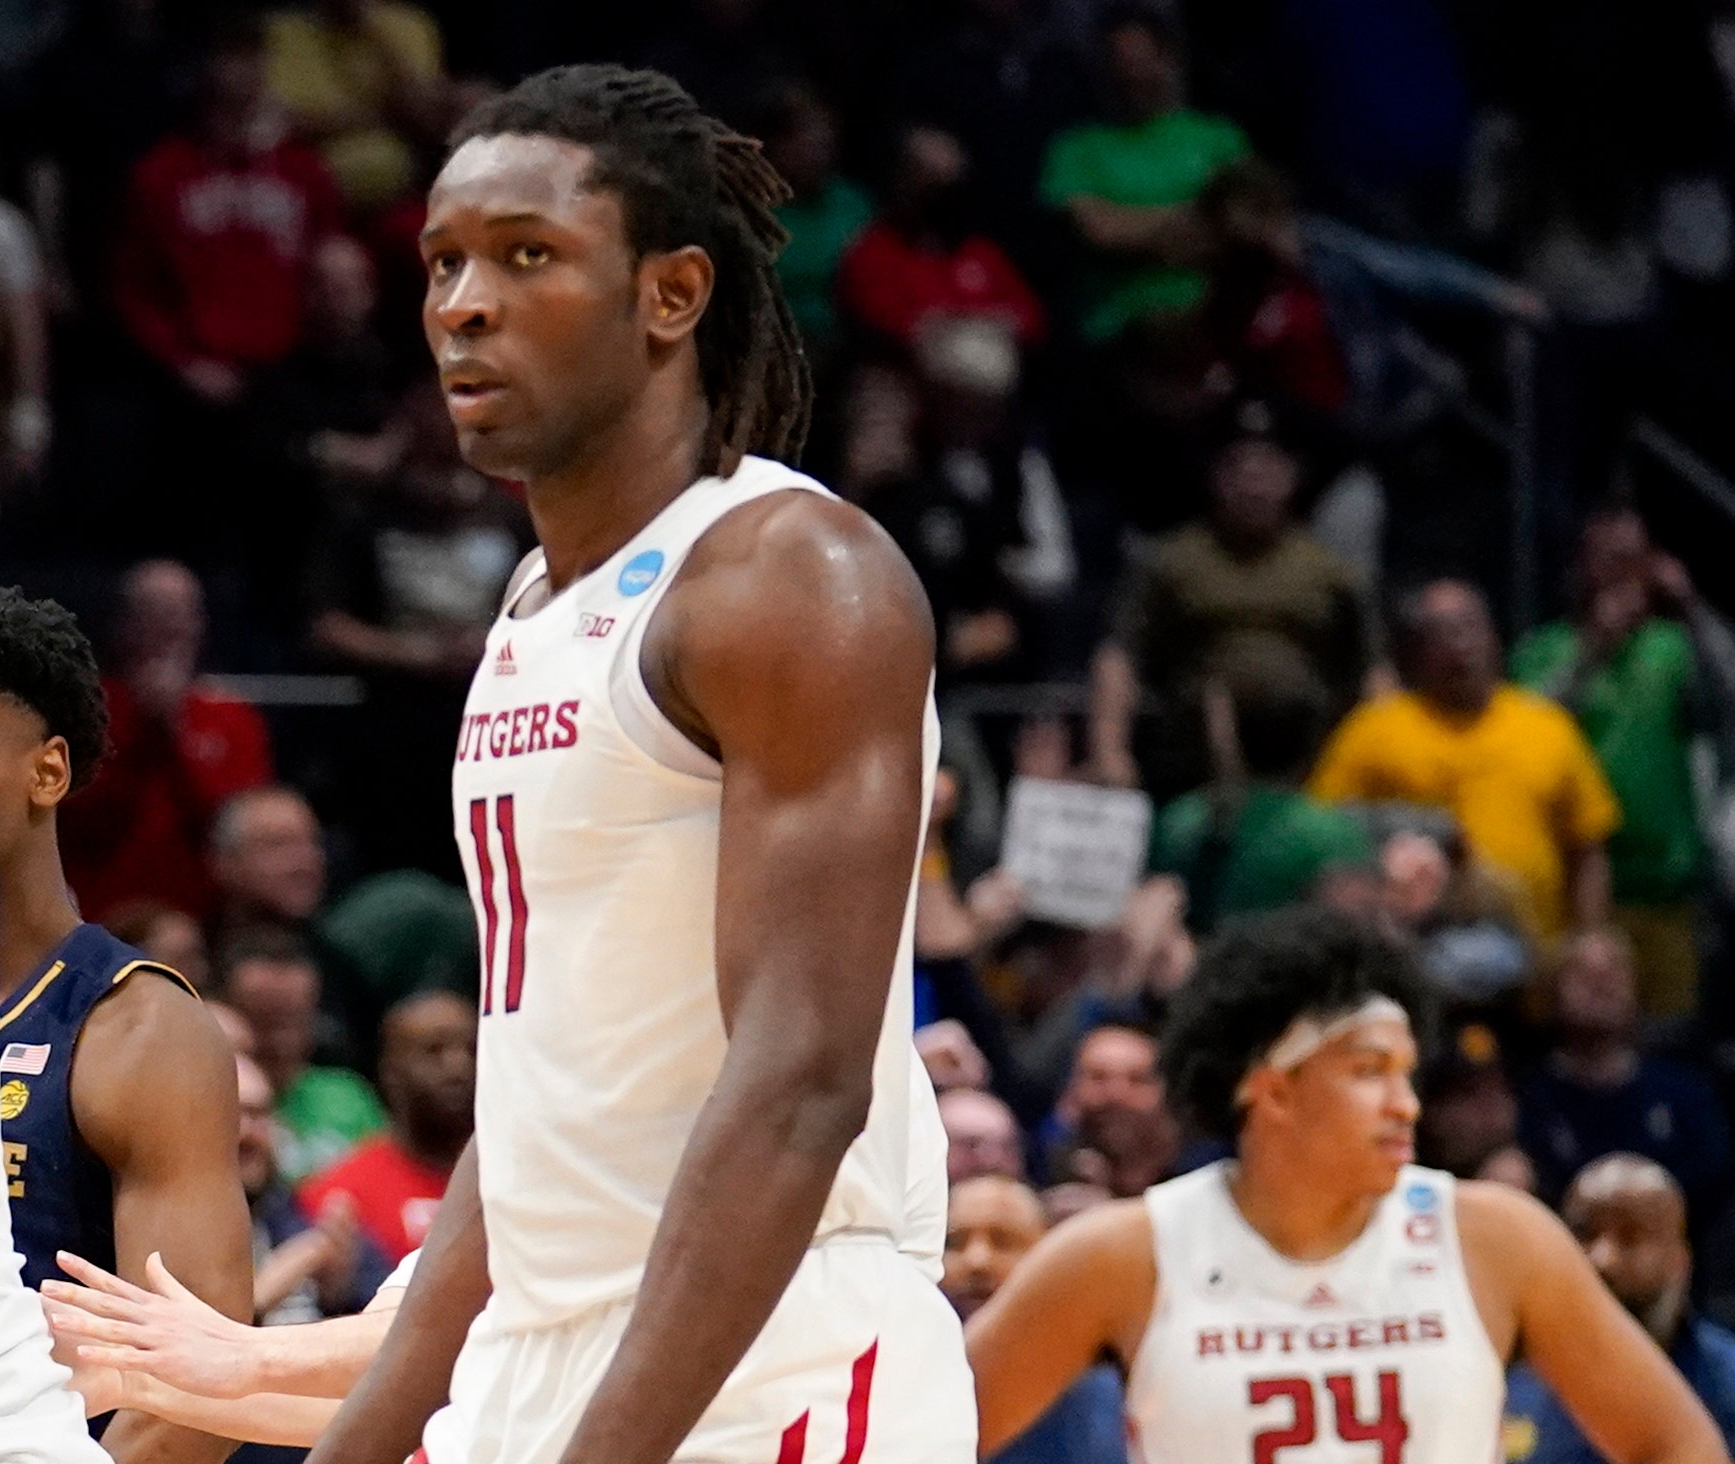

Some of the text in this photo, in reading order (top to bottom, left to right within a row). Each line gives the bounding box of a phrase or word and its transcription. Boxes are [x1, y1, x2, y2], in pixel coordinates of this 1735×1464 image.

[457, 699, 581, 763] UTGERS
[469, 793, 529, 1017] 11
[1198, 1315, 1446, 1356] RUTGERS
